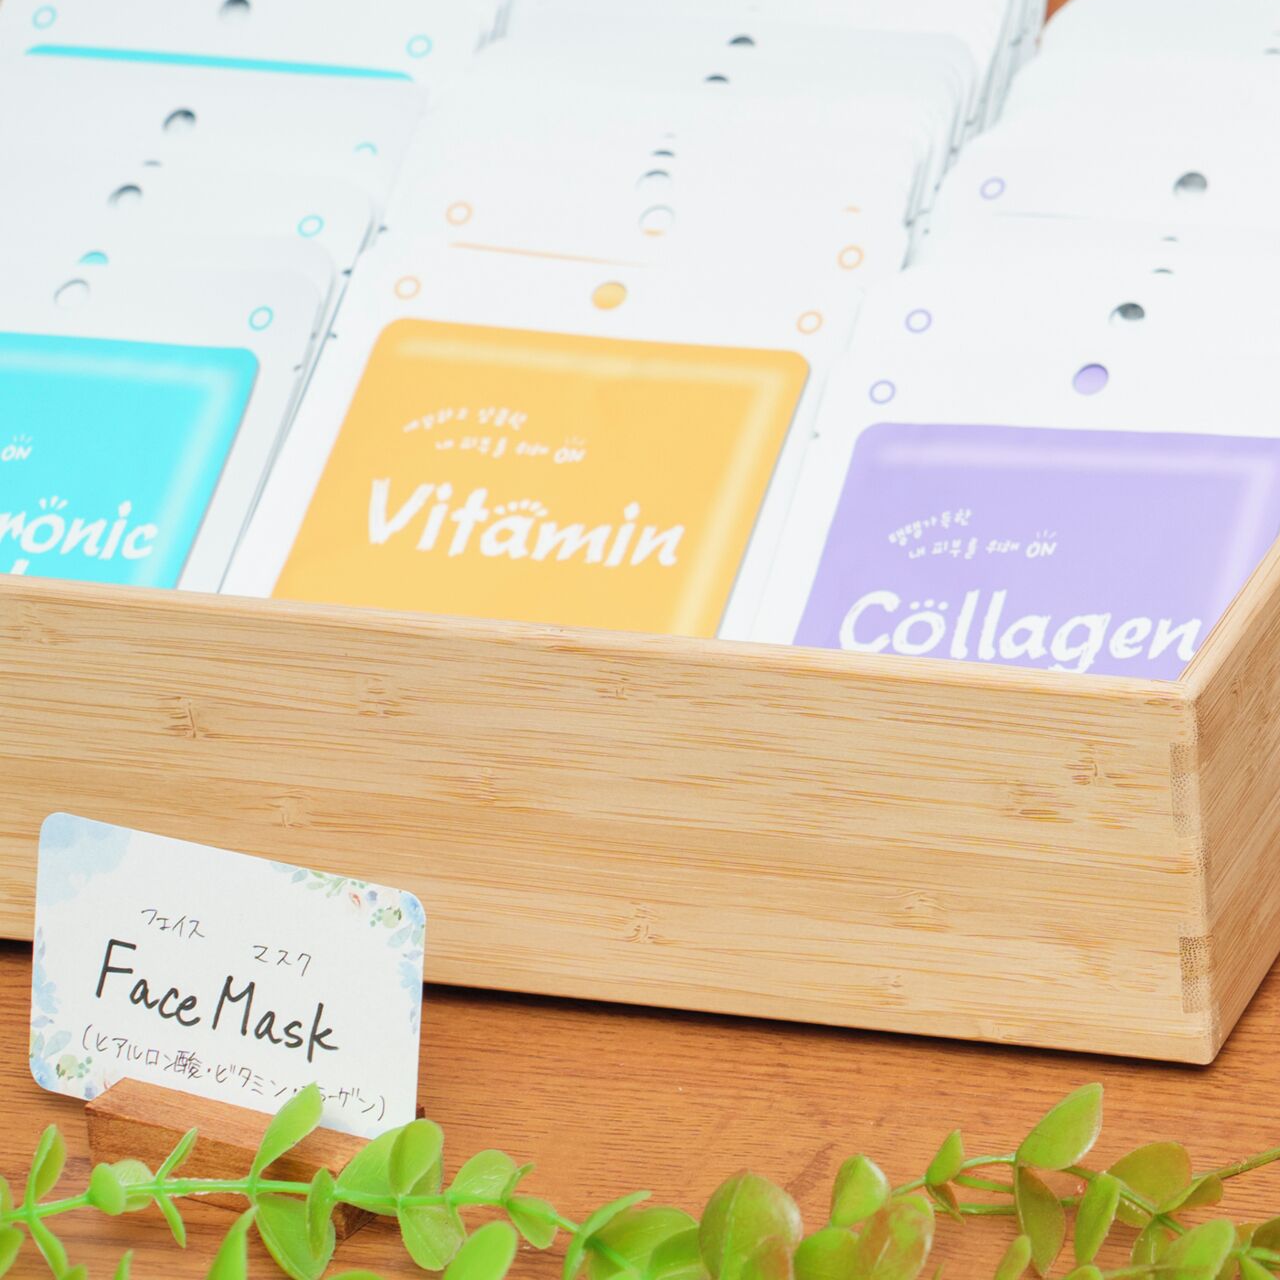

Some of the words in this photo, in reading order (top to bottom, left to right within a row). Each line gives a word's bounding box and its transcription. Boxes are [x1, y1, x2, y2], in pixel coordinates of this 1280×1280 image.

[1, 444, 32, 462] ON
[554, 448, 586, 464] ON
[369, 476, 686, 570] Vitamin
[1025, 541, 1057, 560] ON
[140, 908, 205, 939] フェイス
[253, 944, 312, 977] マスク
[95, 938, 201, 1027] Face
[211, 975, 339, 1063] Mask
